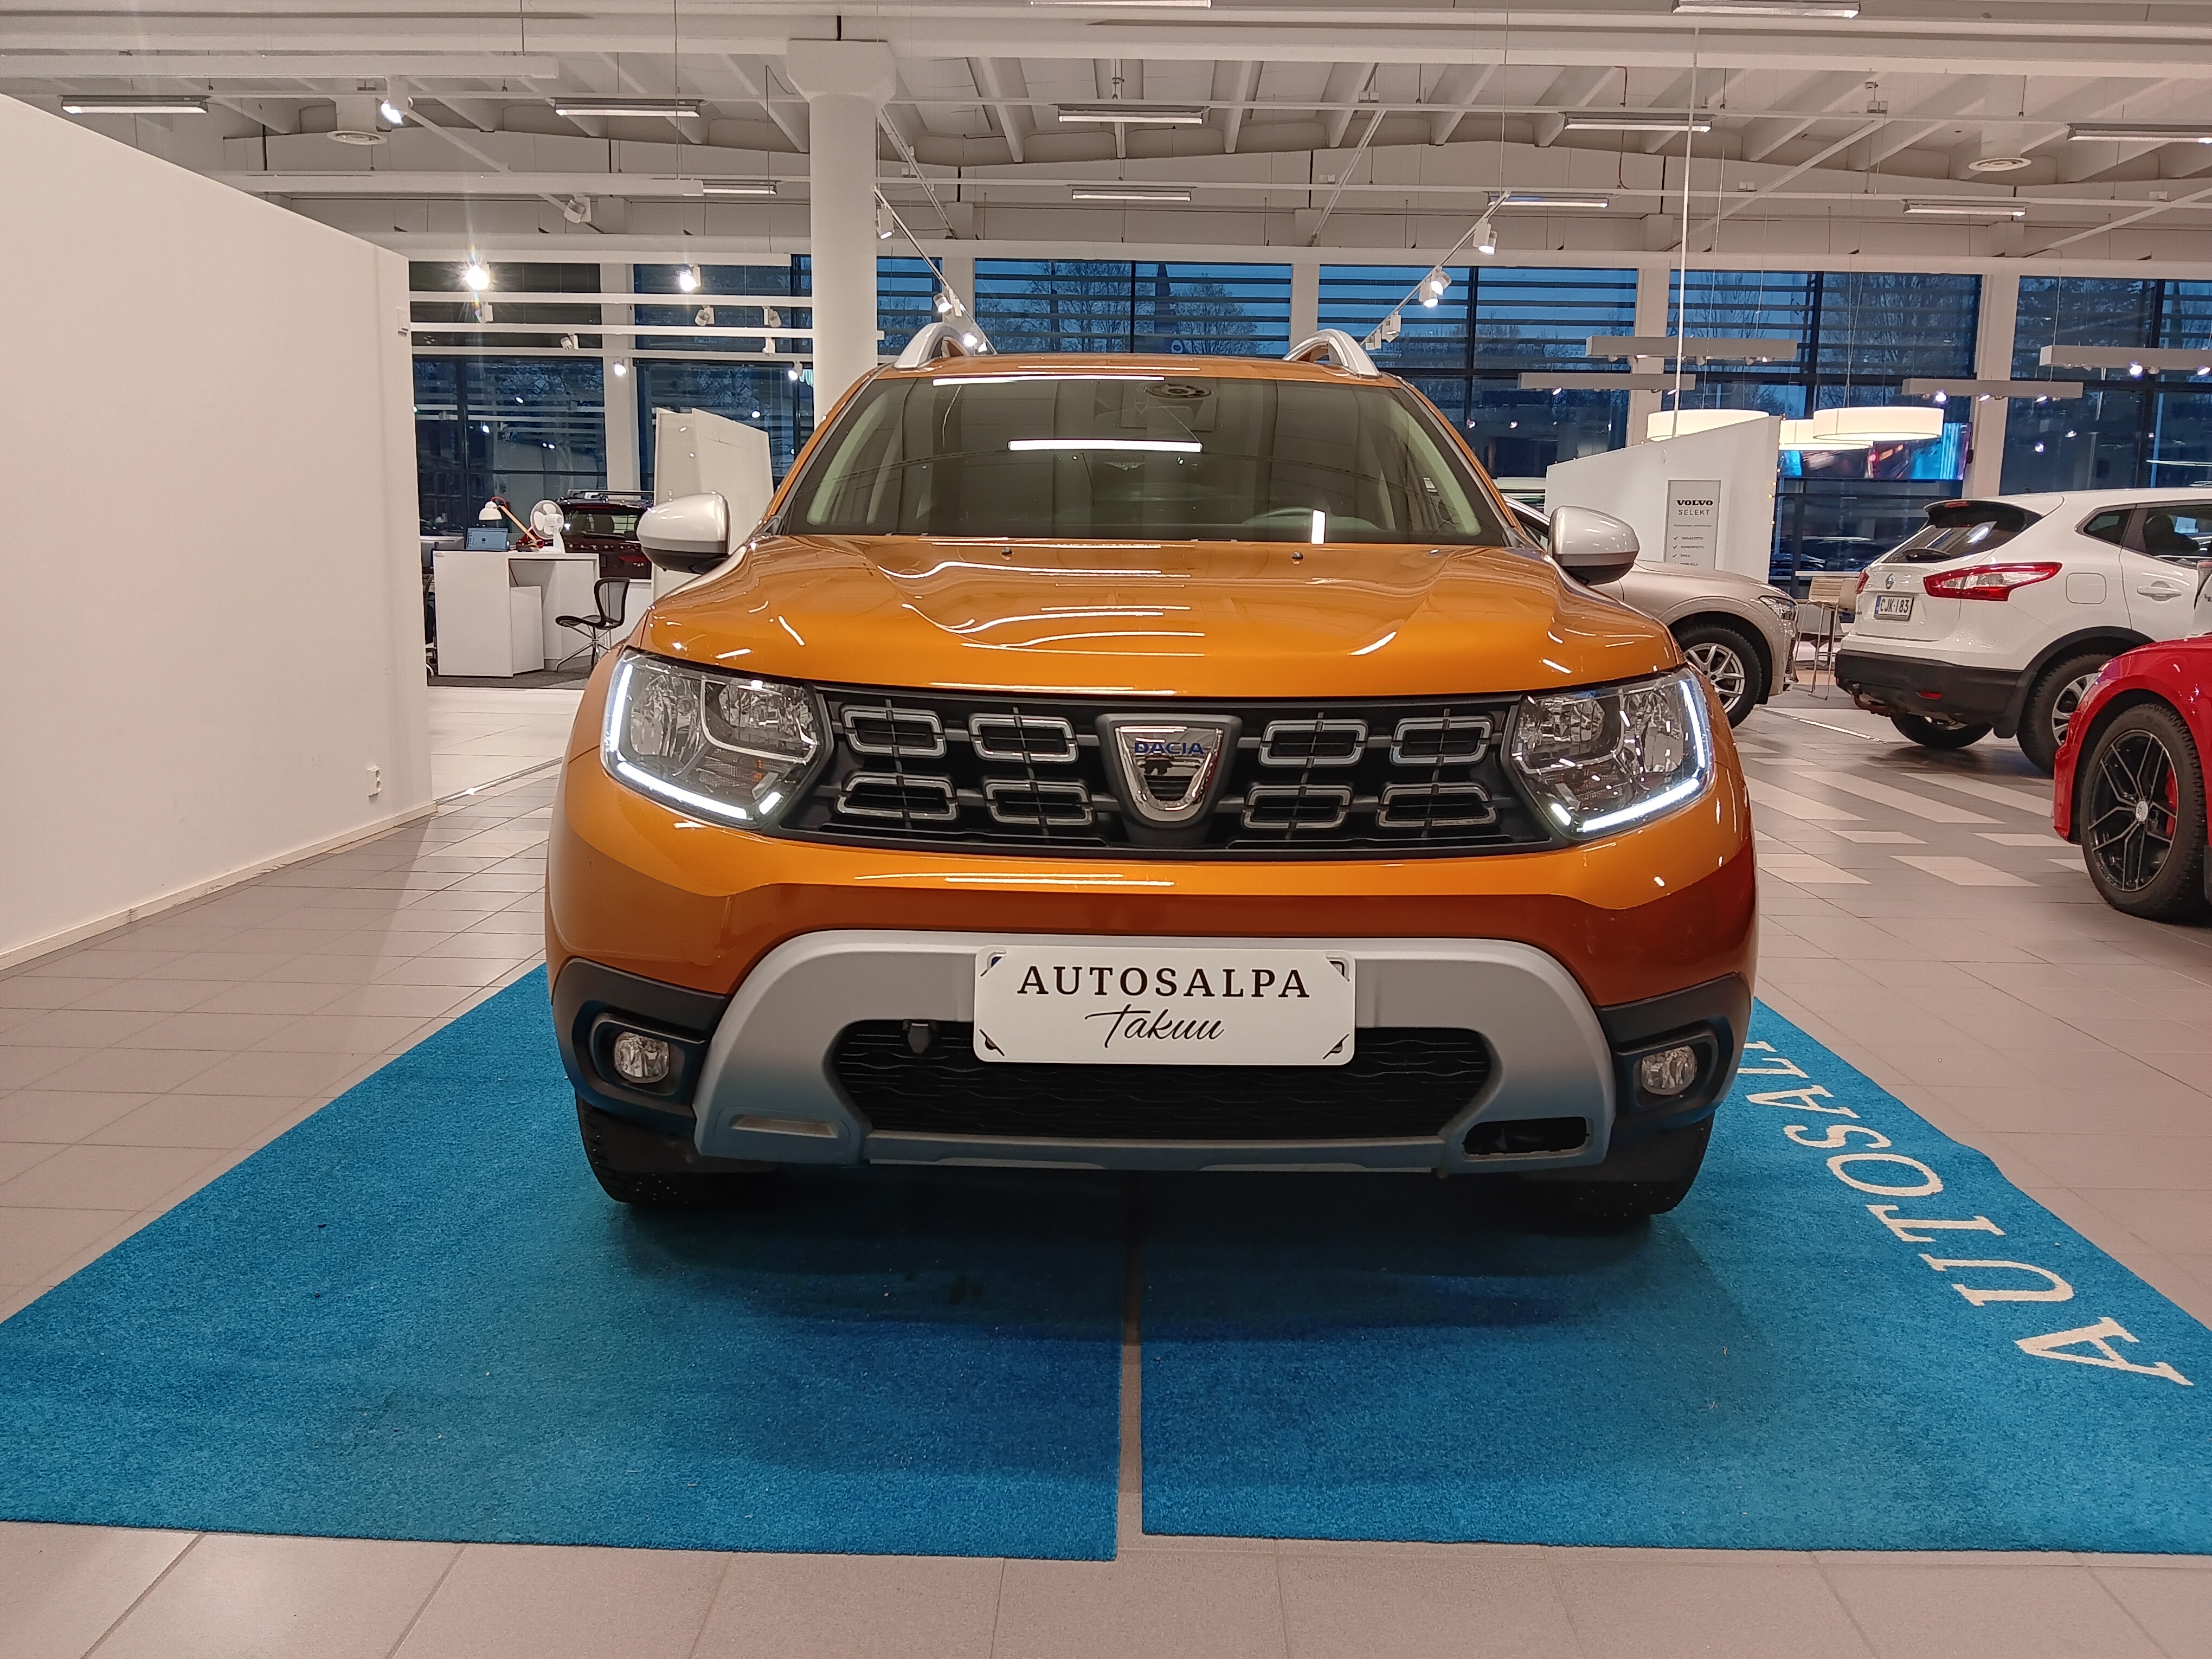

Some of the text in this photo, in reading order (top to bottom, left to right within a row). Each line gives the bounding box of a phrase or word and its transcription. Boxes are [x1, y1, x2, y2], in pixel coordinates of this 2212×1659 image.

[1880, 598, 1909, 613] CJK-183
[1134, 742, 1204, 755] DACIA
[1017, 965, 1310, 998] AUTOSALPA
[1084, 1004, 1224, 1049] Takuu
